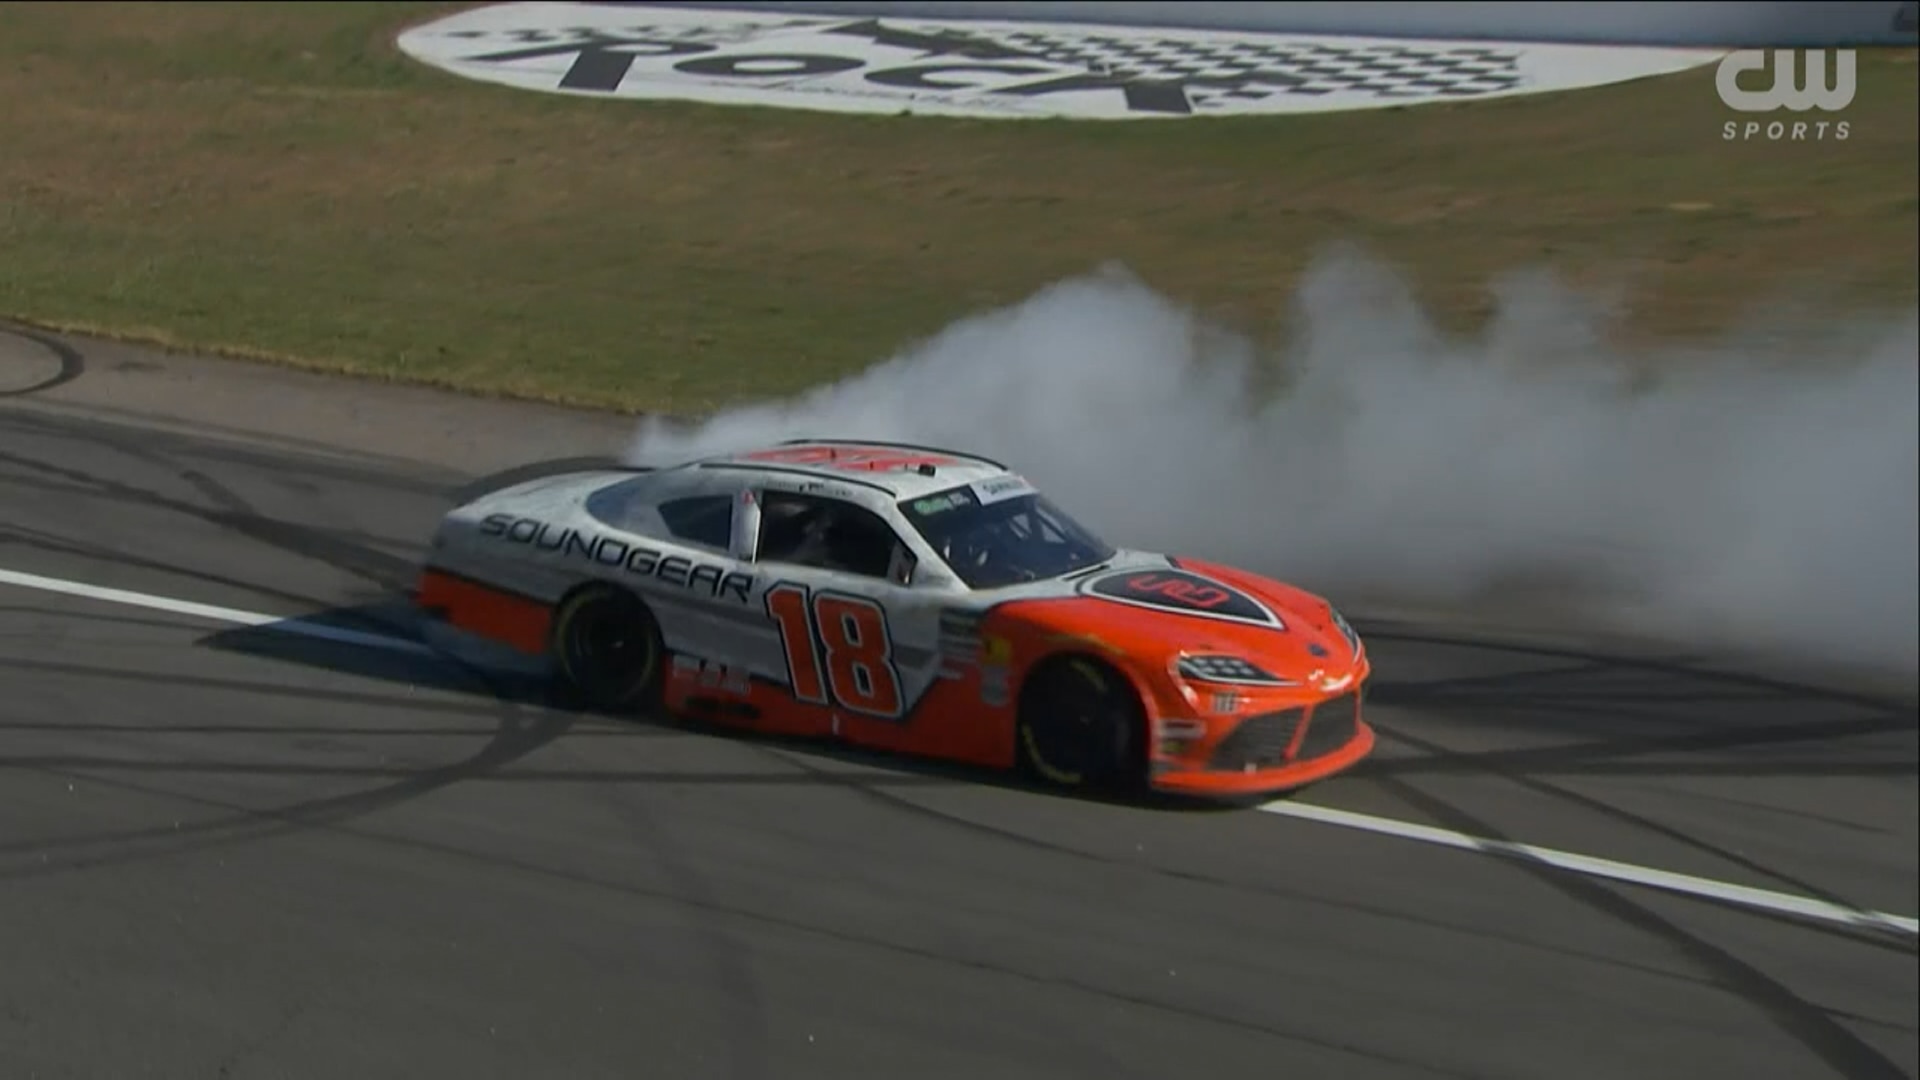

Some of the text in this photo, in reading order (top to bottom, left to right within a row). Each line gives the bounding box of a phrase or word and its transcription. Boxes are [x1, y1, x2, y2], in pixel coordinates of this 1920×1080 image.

[467, 39, 1307, 114] ROCK
[480, 512, 755, 604] SOUNDGEAR
[764, 580, 905, 718] 18
